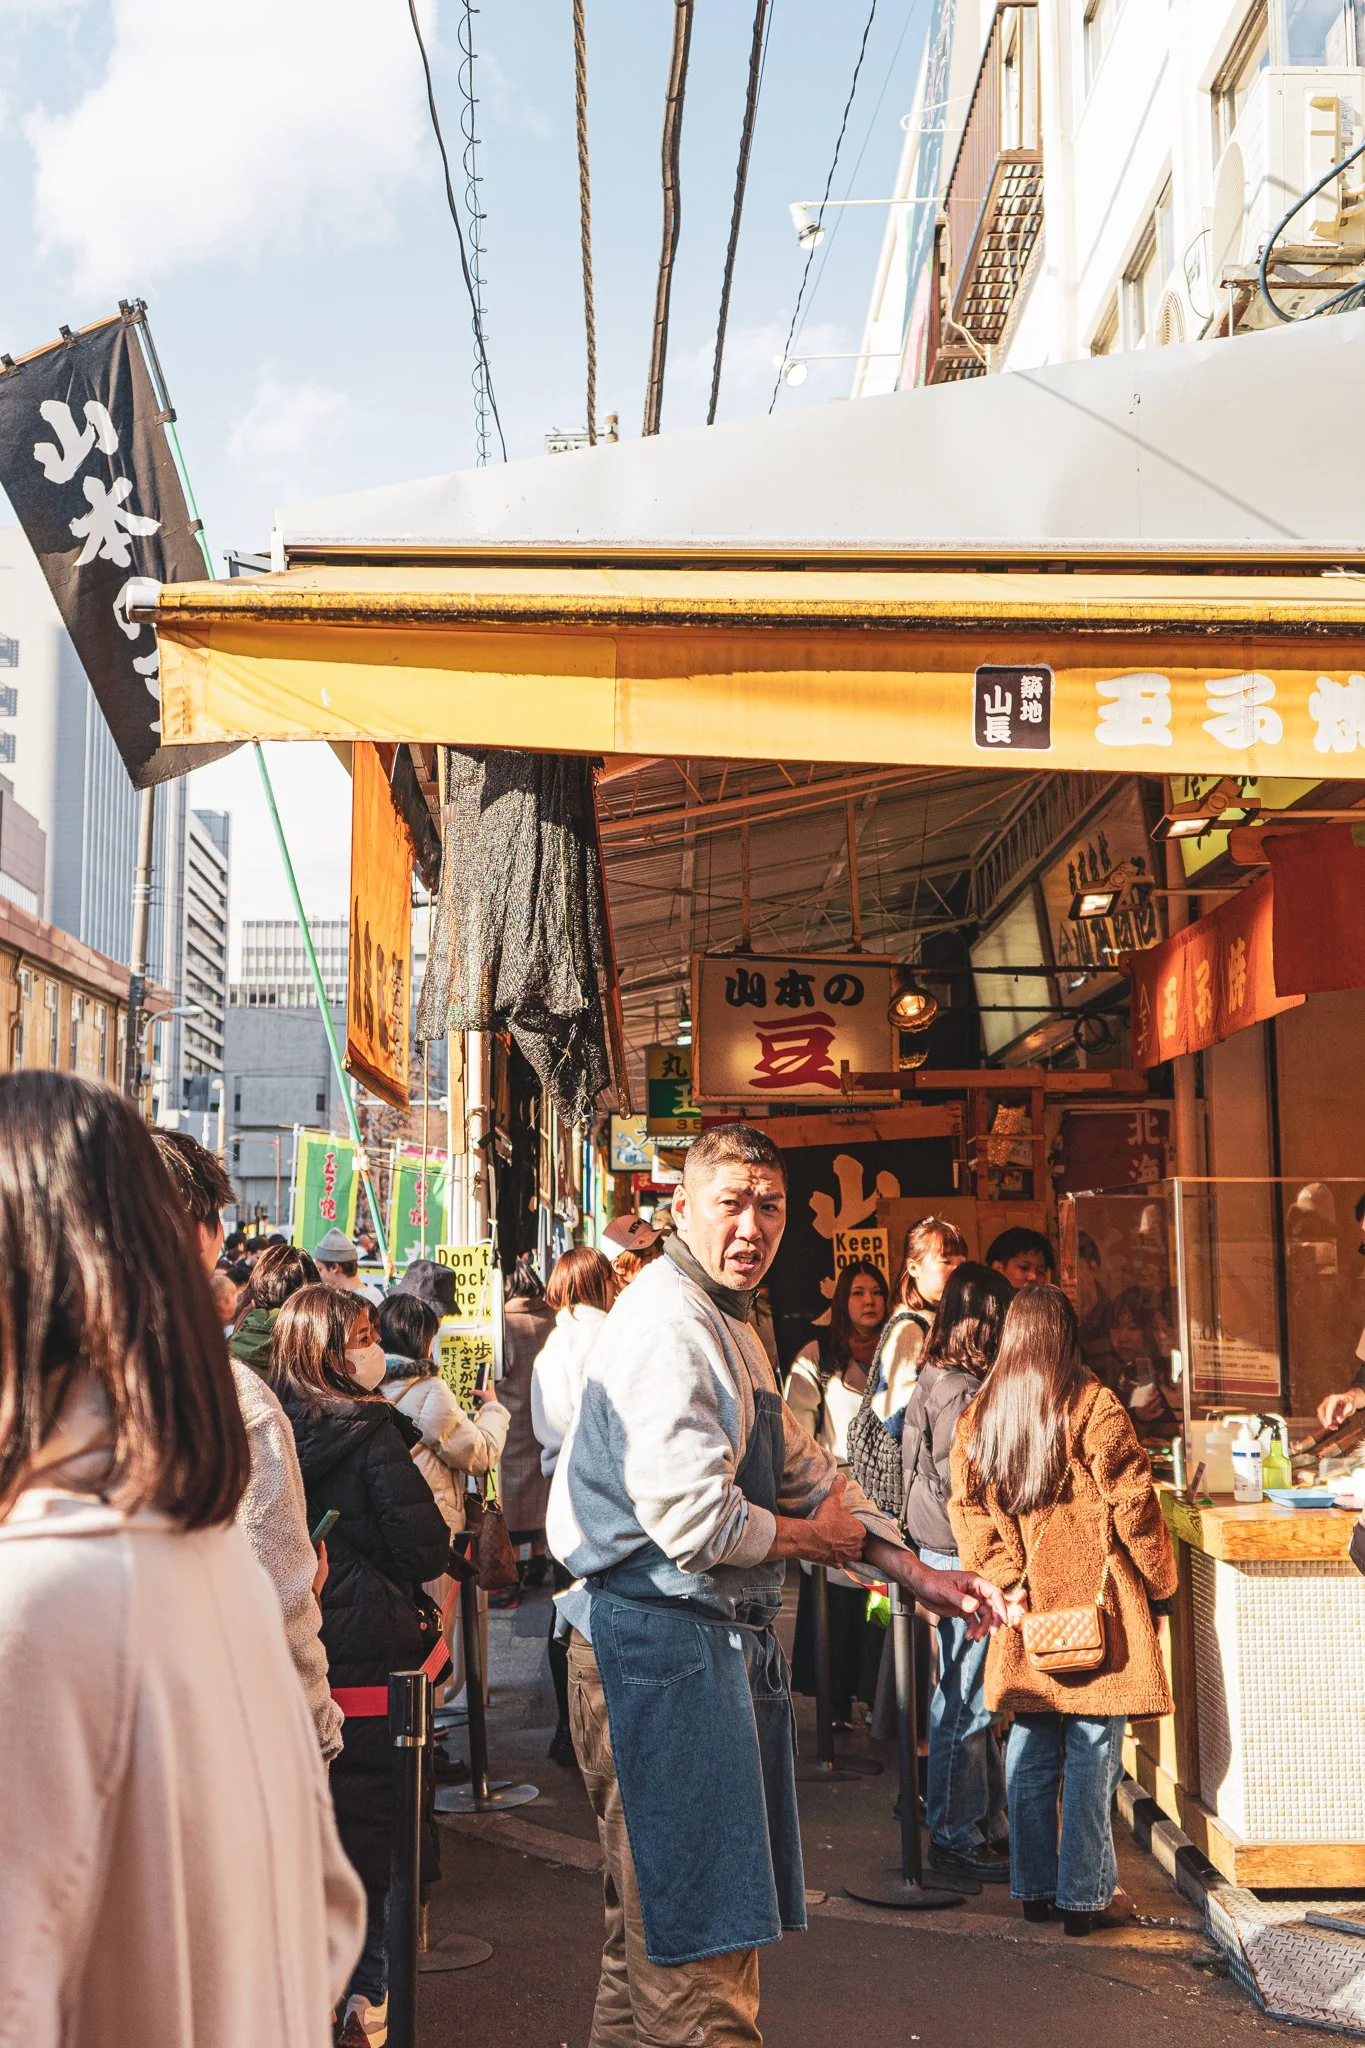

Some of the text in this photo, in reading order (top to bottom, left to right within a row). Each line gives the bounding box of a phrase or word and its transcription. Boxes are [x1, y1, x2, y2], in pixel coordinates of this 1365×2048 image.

[34, 400, 162, 734] 山本
[984, 685, 1012, 744] 山長
[1020, 675, 1043, 723] 築地
[725, 968, 864, 1007] 山本の
[748, 1011, 841, 1089] 豆
[438, 1247, 489, 1267] Don't
[836, 1232, 882, 1252] Keep
[456, 1288, 476, 1304] he
[457, 1268, 489, 1286] ock
